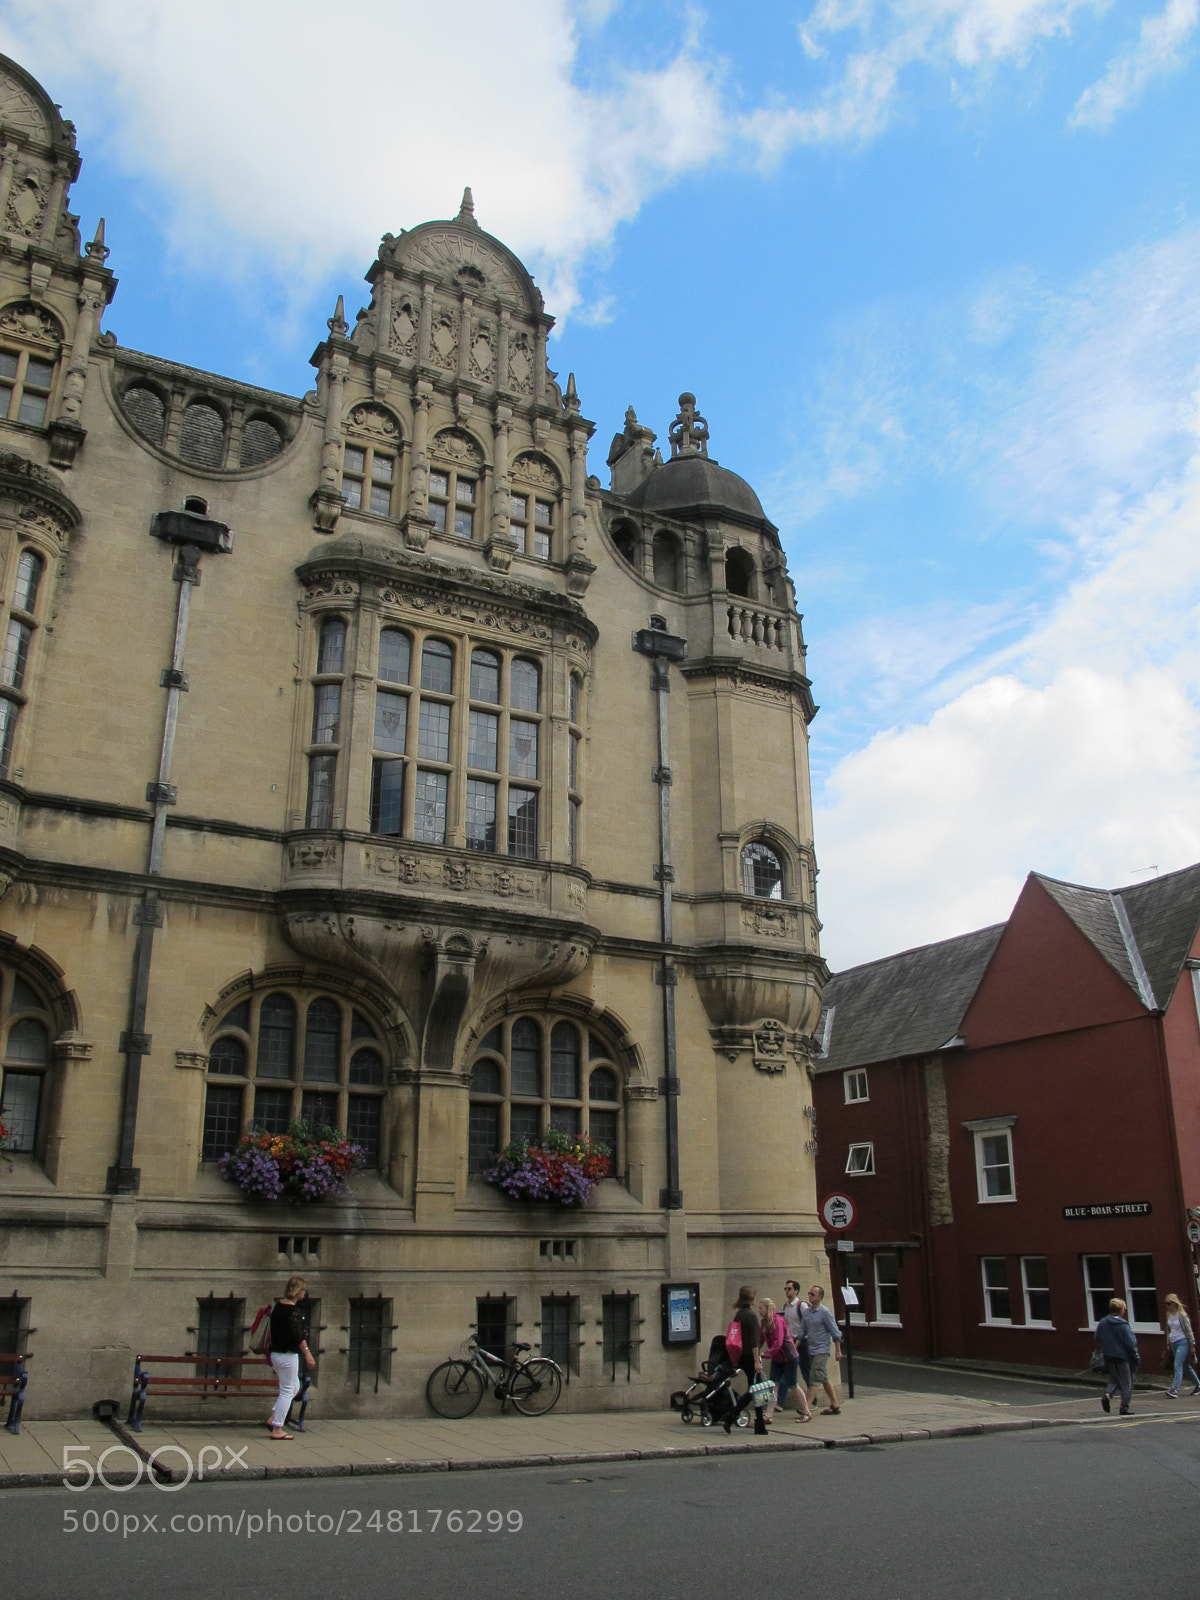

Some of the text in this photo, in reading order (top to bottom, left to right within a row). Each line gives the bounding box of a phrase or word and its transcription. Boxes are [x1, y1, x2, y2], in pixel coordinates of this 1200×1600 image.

[1065, 1203, 1148, 1216] BLUE BOAR STREET
